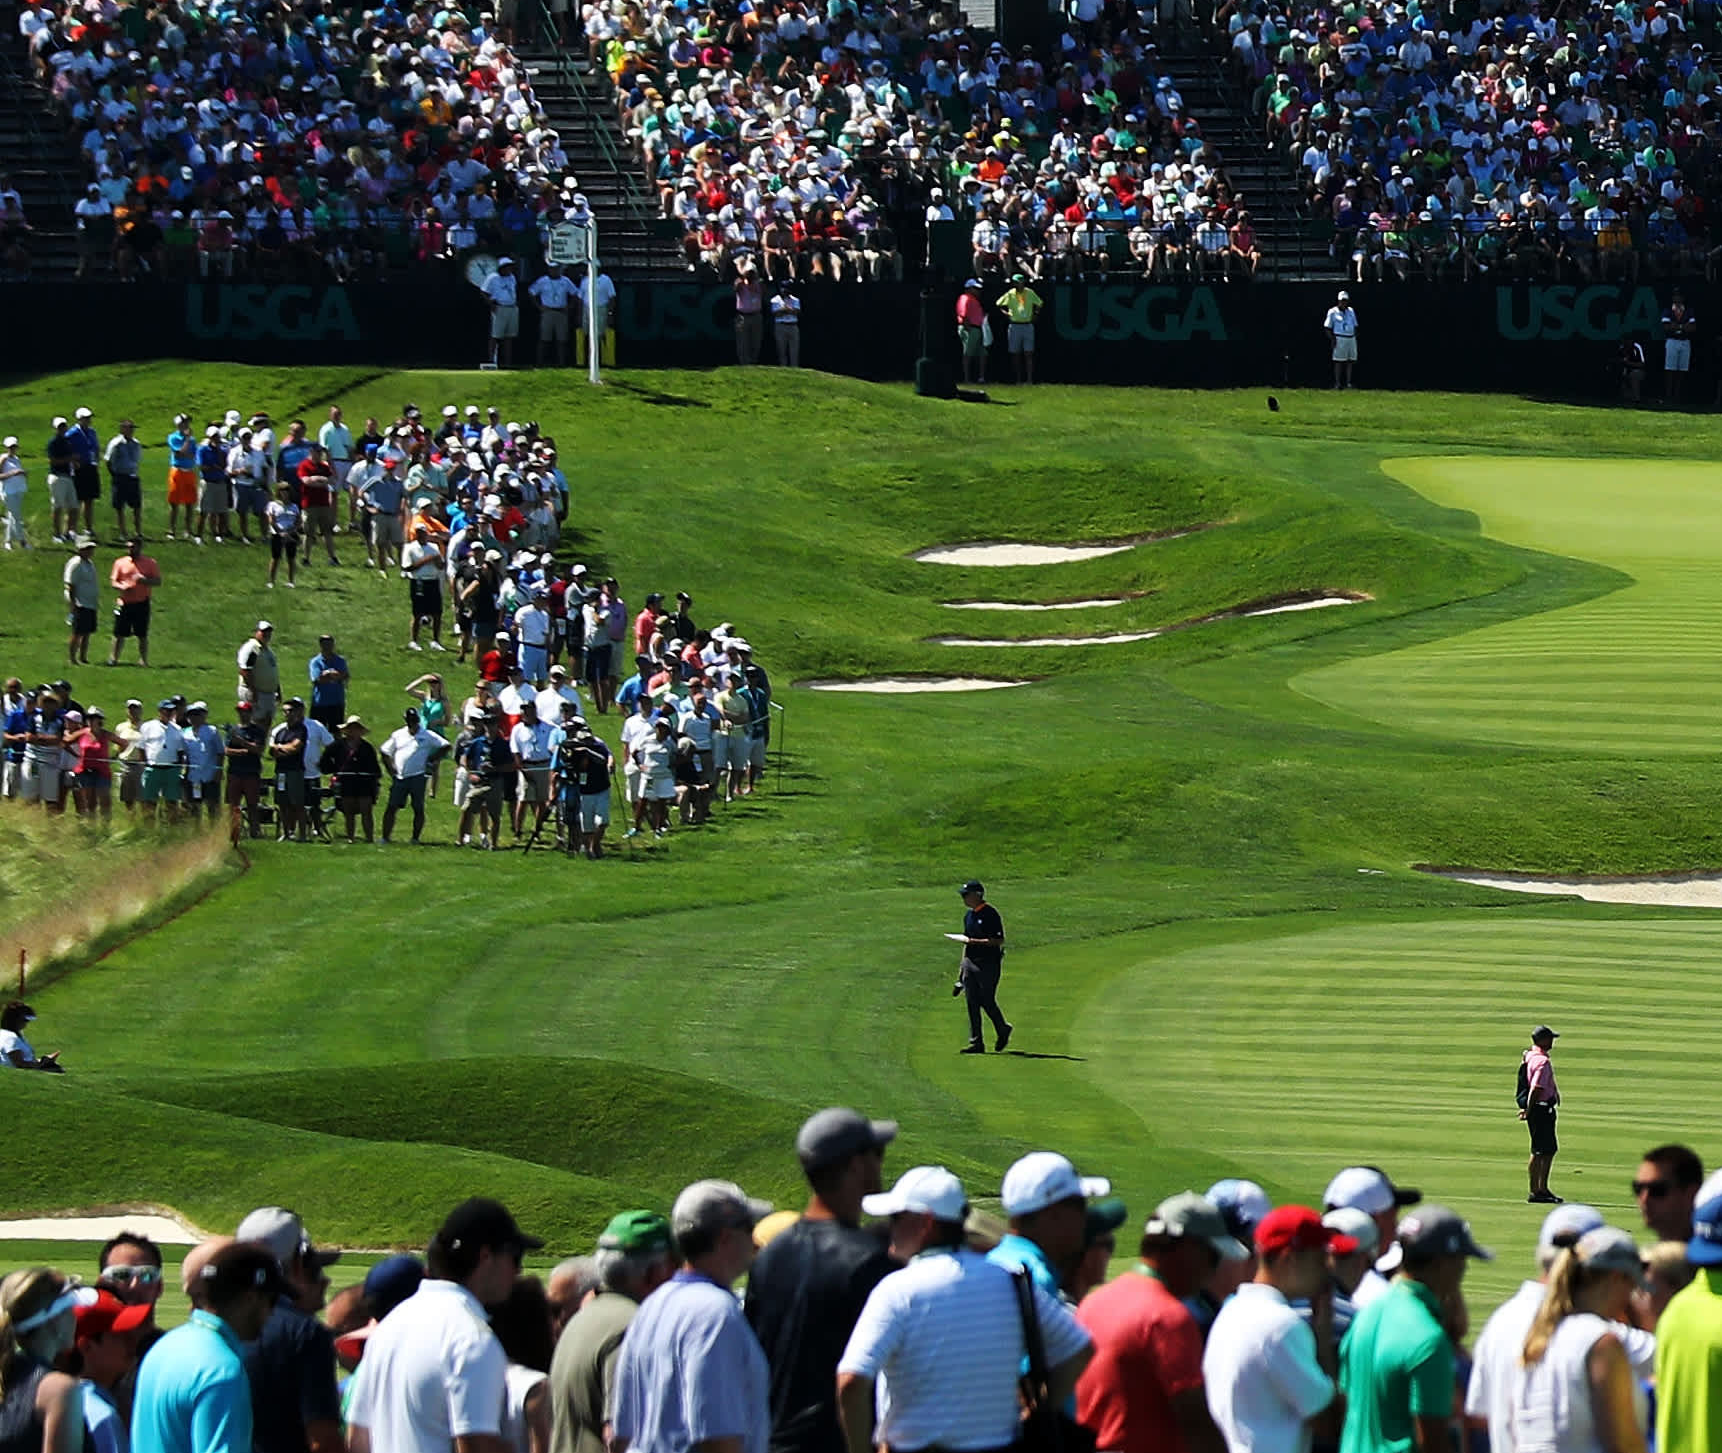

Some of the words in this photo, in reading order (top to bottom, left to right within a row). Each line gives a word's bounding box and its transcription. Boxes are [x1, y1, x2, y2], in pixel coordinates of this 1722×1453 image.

[185, 284, 361, 340] USGA
[620, 284, 738, 340] USG
[1053, 284, 1229, 340] USGA
[1496, 284, 1665, 340] USGA
